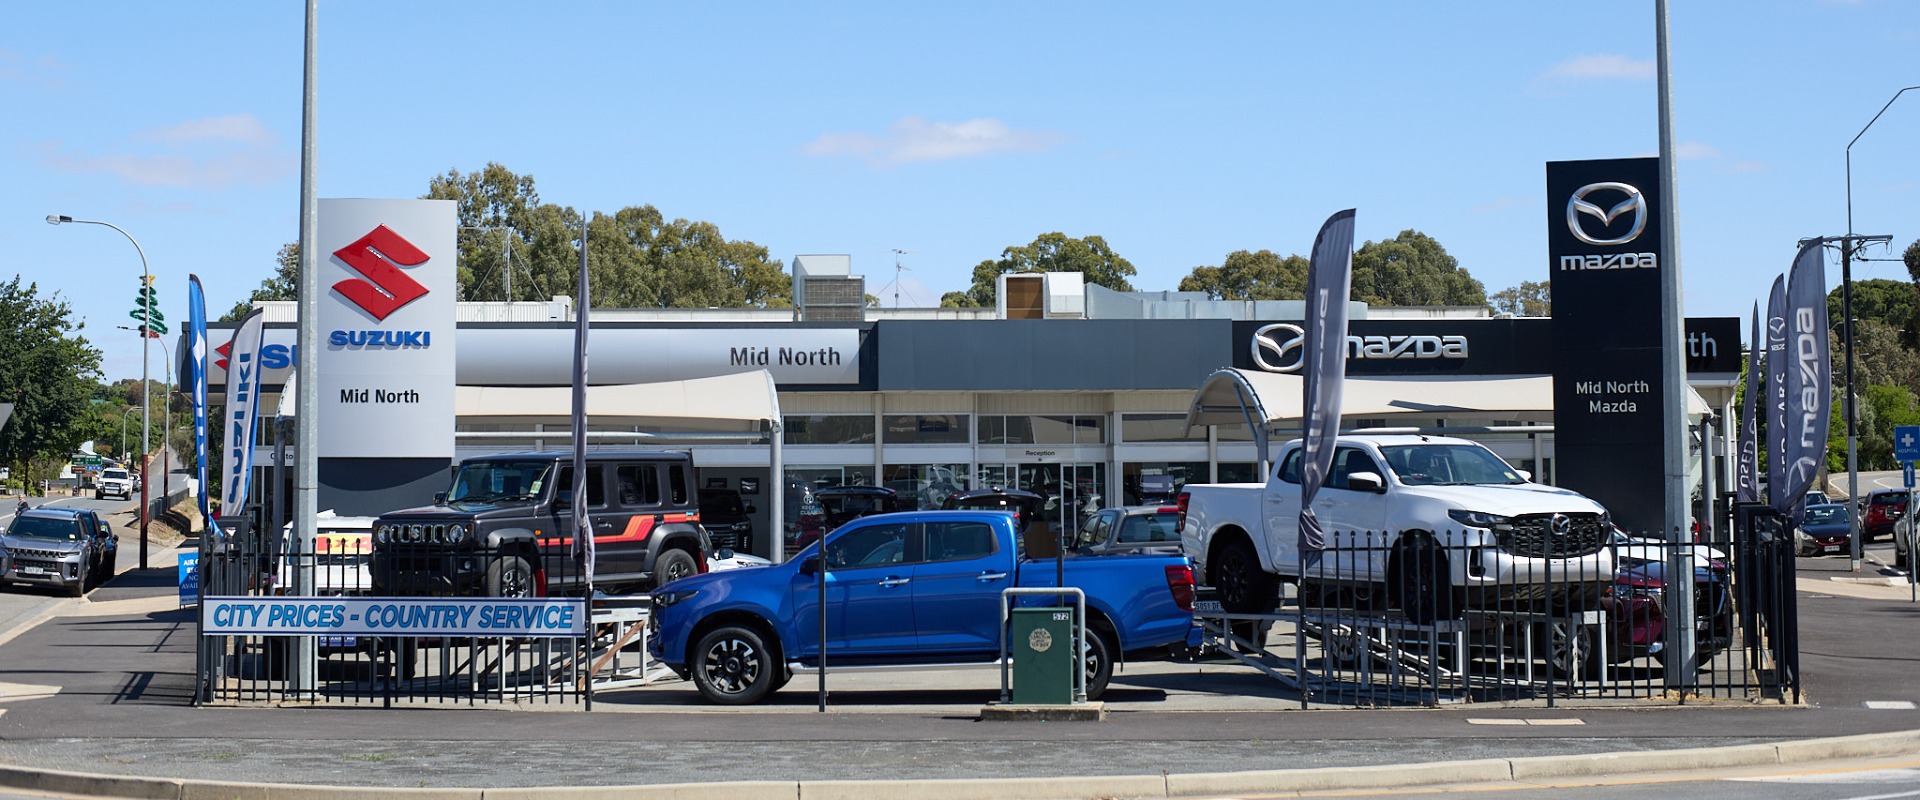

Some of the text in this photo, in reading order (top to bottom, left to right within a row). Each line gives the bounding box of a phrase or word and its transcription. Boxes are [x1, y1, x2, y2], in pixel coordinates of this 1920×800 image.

[330, 330, 431, 347] SUZUKI
[730, 347, 841, 366] Mid North
[1576, 380, 1649, 394] Mid North
[340, 388, 419, 404] Mid North
[1589, 400, 1637, 413] Mazda
[213, 604, 265, 627] CITY
[267, 604, 345, 628] PRICES
[365, 604, 476, 629] COUNTRY
[478, 605, 575, 629] SERVICE
